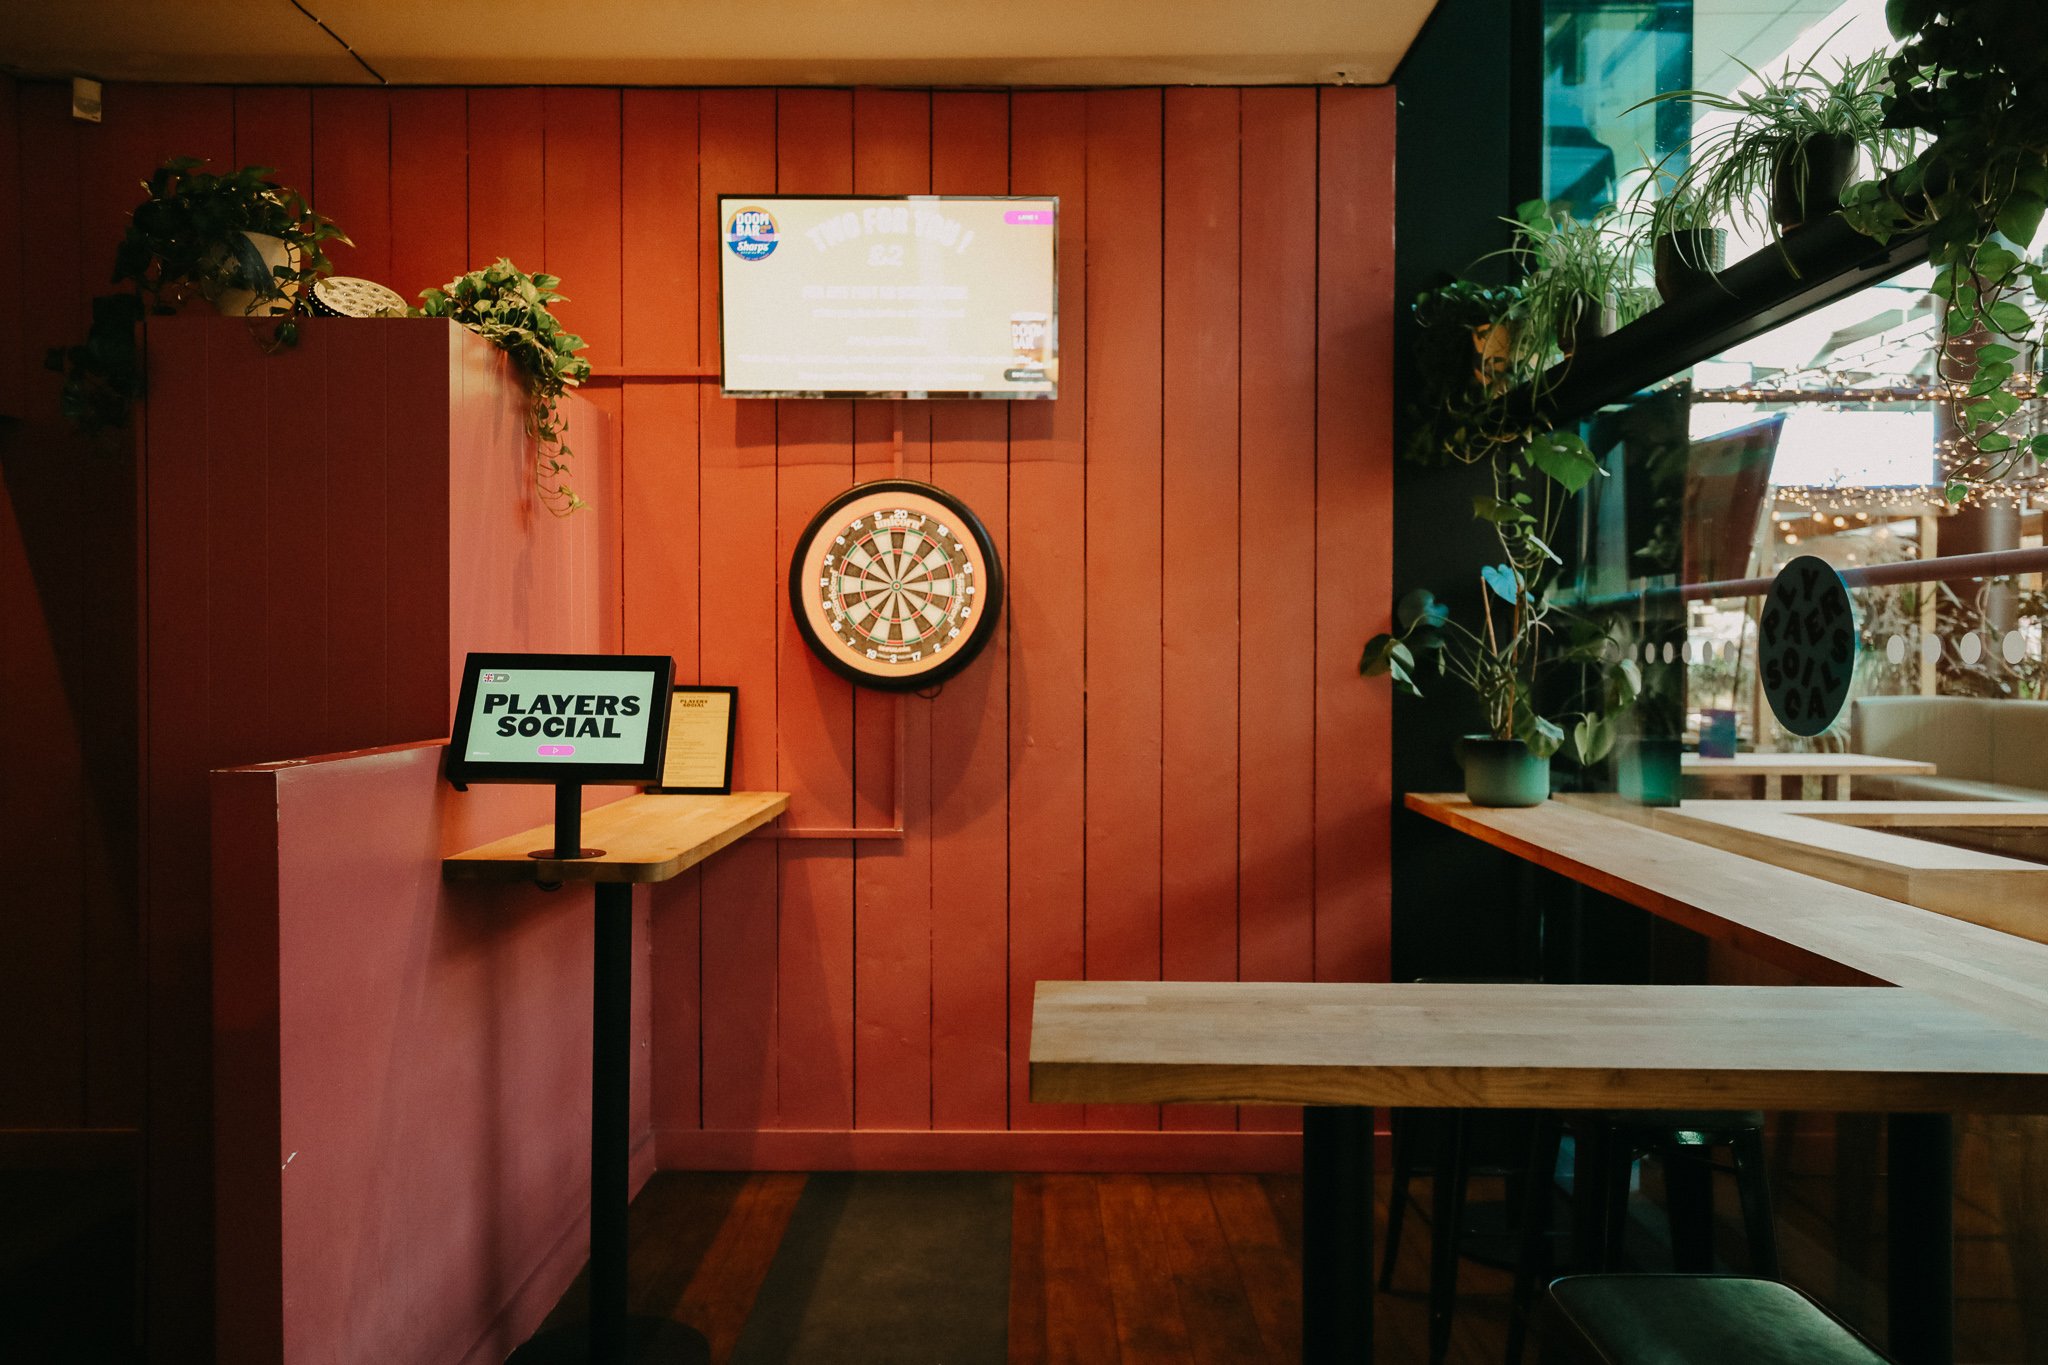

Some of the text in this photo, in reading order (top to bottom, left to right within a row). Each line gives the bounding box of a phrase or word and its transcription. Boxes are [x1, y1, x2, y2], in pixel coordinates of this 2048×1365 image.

[736, 212, 770, 225] DOOM
[736, 224, 760, 236] BAR
[806, 210, 860, 254] TWO
[863, 206, 908, 234] FOR
[867, 245, 904, 267] £2
[874, 512, 882, 520] 5
[894, 509, 908, 519] 20
[920, 515, 926, 524] 1
[851, 519, 864, 531] 12
[847, 637, 856, 646] 7
[933, 643, 942, 653] 2
[889, 654, 897, 663] 3
[483, 694, 640, 716] PLAYERS
[496, 716, 621, 738] SOCIAL
